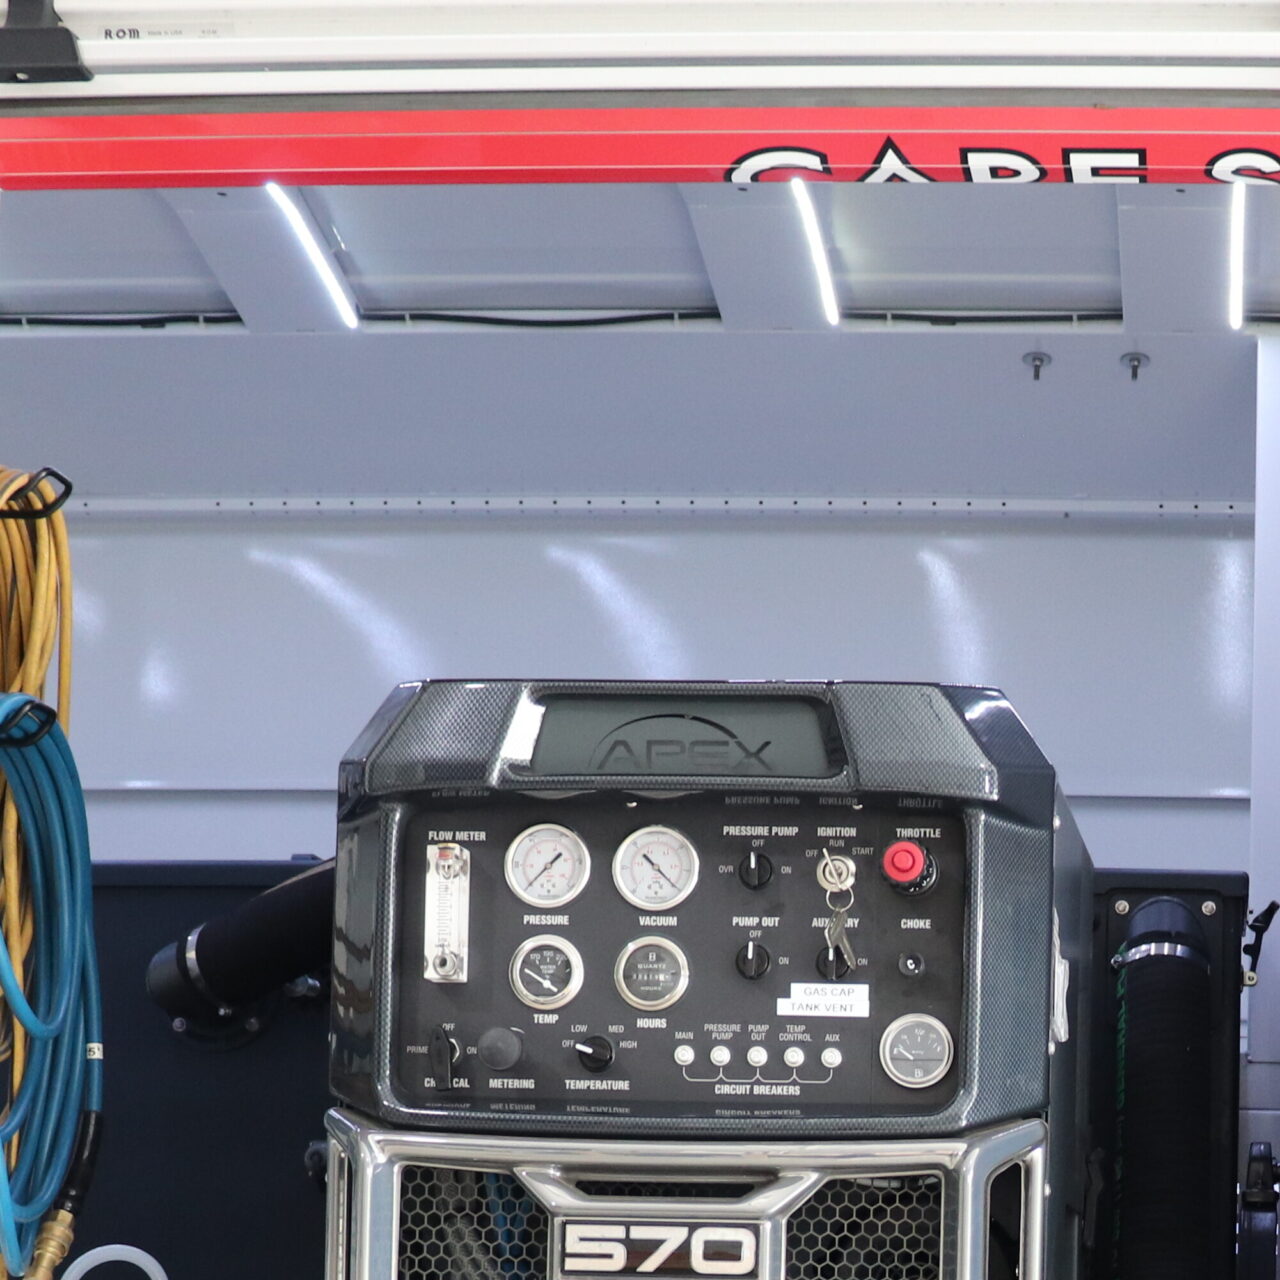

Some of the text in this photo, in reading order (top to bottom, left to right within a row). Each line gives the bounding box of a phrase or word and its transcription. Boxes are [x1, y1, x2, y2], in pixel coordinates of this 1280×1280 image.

[597, 740, 773, 771] APEX
[428, 831, 487, 841] FLOW METER
[723, 826, 799, 837] PRESSURE PUMP
[817, 827, 857, 838] IGNITION
[896, 828, 941, 839] THROTTLE
[752, 839, 765, 848] OFF
[829, 839, 845, 848] RUN
[805, 849, 819, 858] OFF
[852, 847, 874, 856] START
[718, 865, 734, 874] OVR
[781, 866, 792, 874] ON
[523, 915, 570, 925] PRESSURE
[638, 916, 678, 926] VACUUM
[732, 916, 780, 927] PUMP OUT
[901, 919, 932, 930] CHOKE
[750, 930, 762, 938] OFF
[778, 956, 789, 965] ON
[857, 957, 868, 966] ON
[803, 987, 855, 997] GAS CAP
[790, 1002, 855, 1013] TANK VENT
[534, 1014, 559, 1025] TEMP
[636, 1018, 667, 1029] HOURS
[570, 1025, 588, 1033] LOW
[608, 1025, 625, 1033] MED
[704, 1024, 741, 1032] PRESSURE
[748, 1025, 770, 1033] PUMP
[786, 1025, 806, 1033] TEMP
[675, 1032, 694, 1040] MAIN
[712, 1032, 733, 1041] PUMP
[751, 1033, 765, 1041] OUT
[779, 1033, 812, 1042] CONTROL
[825, 1034, 840, 1042] AUX
[562, 1040, 575, 1048] OFF
[619, 1040, 637, 1049] HIGH
[406, 1046, 429, 1054] PRIME
[467, 1047, 478, 1055] ON
[424, 1078, 470, 1089] CHCAL
[489, 1078, 535, 1089] METERING
[565, 1080, 630, 1091] TEMPERATURE
[715, 1084, 801, 1096] CIRCUIT BREAKERS
[564, 1224, 756, 1275] 570
